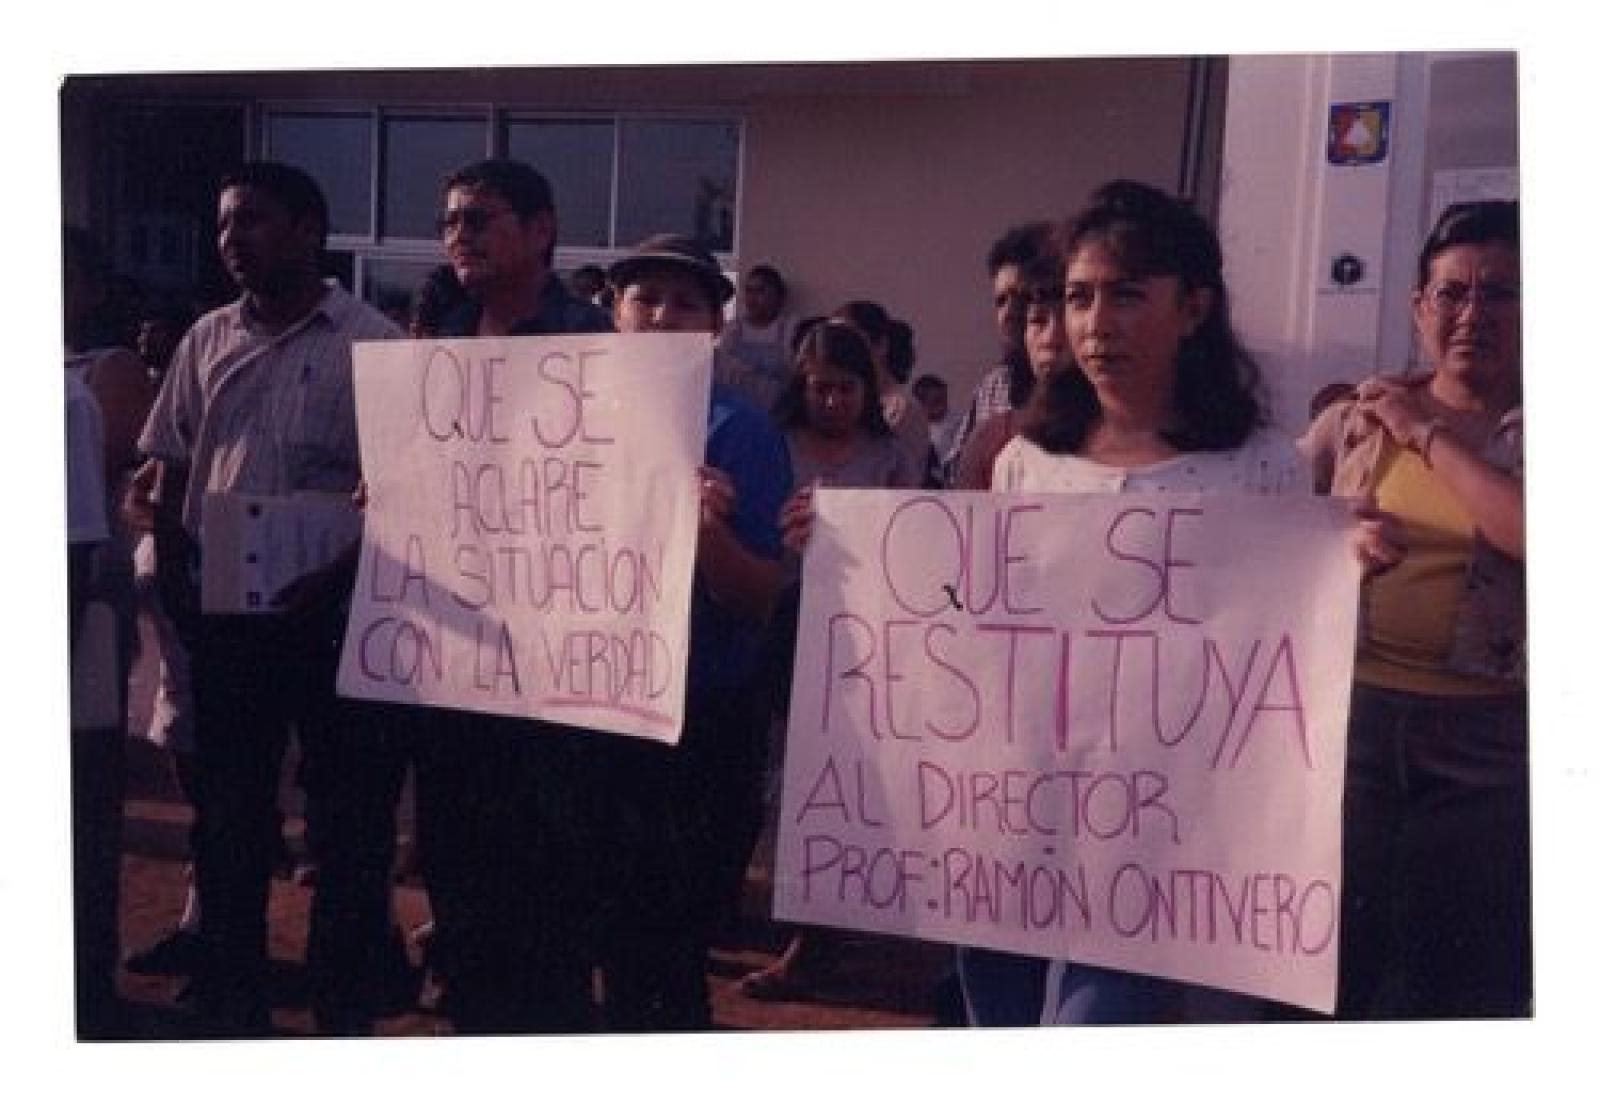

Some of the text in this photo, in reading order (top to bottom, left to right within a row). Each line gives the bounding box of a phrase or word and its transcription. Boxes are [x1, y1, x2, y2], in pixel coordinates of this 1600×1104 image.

[422, 346, 616, 448] QUE SE
[450, 457, 605, 538] ACLARE
[370, 534, 430, 606] LA
[882, 497, 1204, 625] QUE SE
[358, 617, 674, 699] CON LA VERDAD
[820, 613, 1313, 770] RESTITUYA
[796, 755, 1181, 845] AL DIRECTOR
[1106, 863, 1335, 956] ONTIVERO
